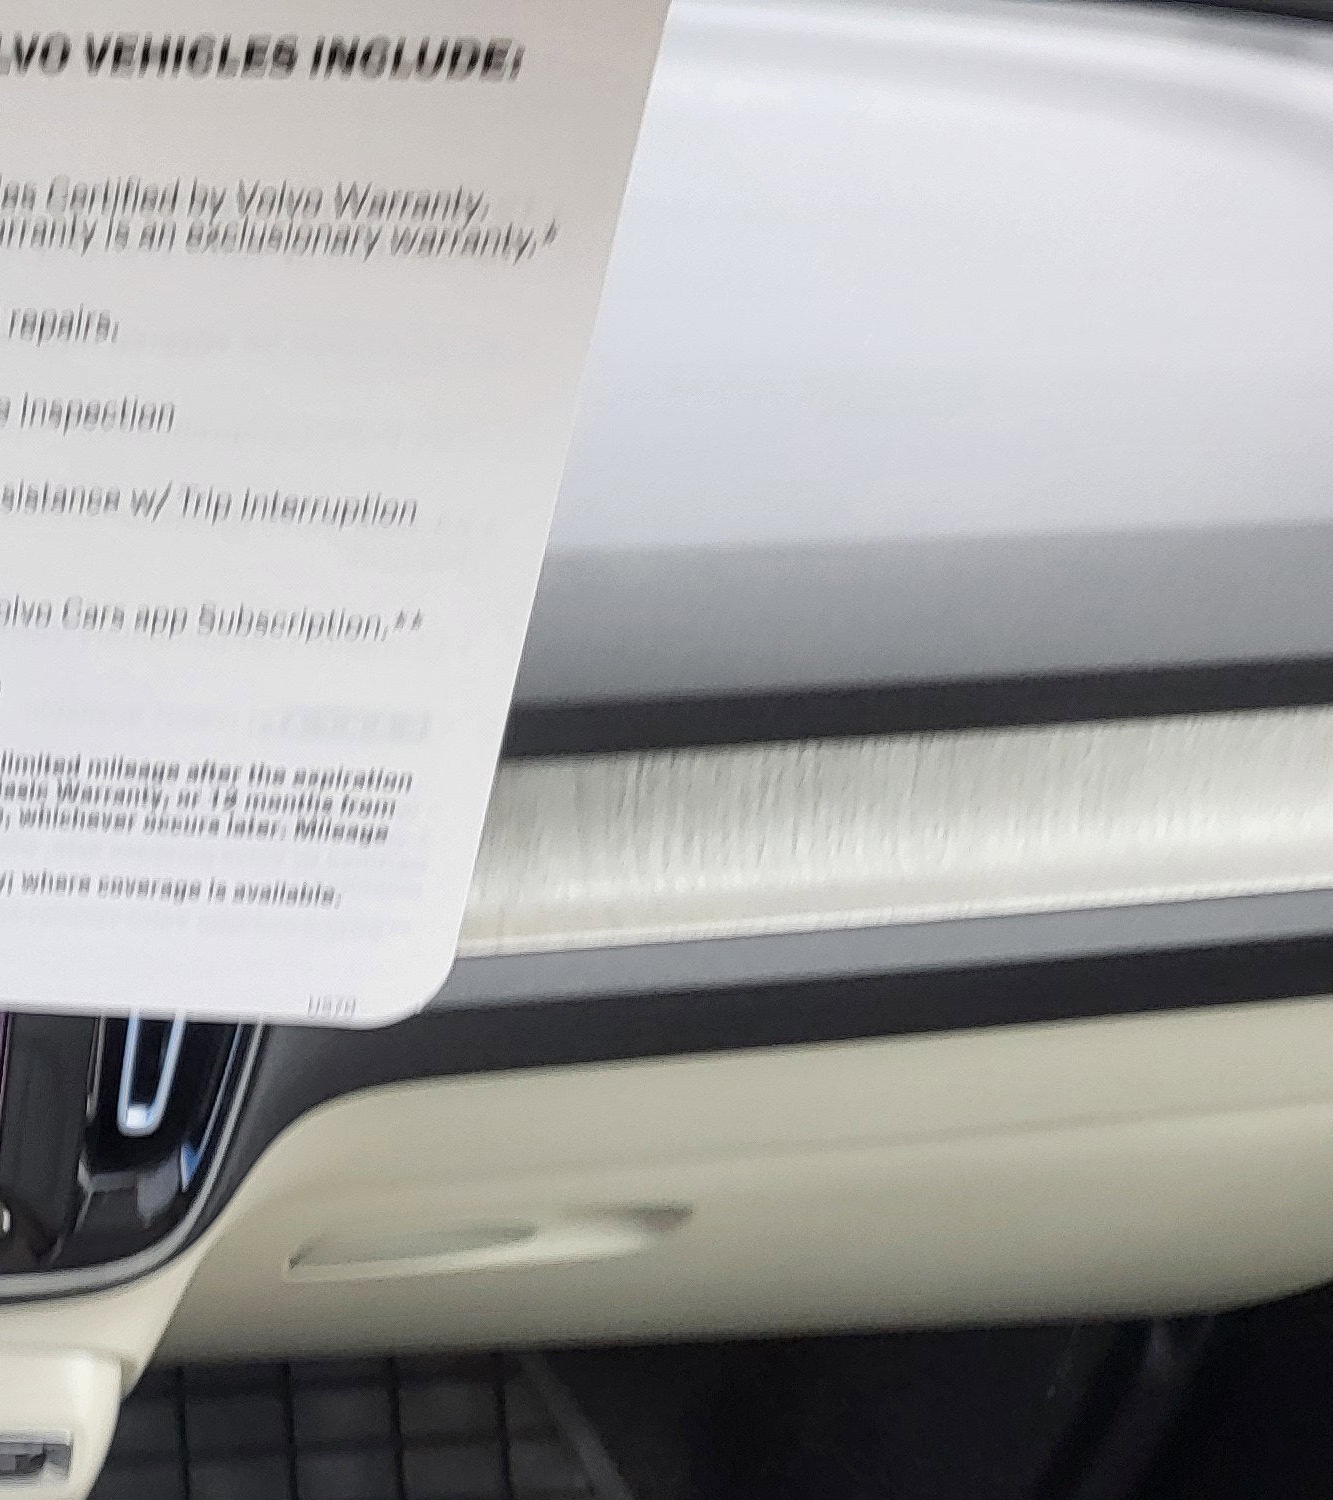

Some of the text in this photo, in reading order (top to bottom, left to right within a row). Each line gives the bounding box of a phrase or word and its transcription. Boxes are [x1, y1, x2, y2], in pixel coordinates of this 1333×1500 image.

[85, 32, 298, 80] VEHICLES
[47, 174, 180, 218] Certified
[190, 177, 226, 225] by
[236, 178, 323, 220] Volvo
[105, 213, 130, 250] is
[138, 221, 176, 254] an
[185, 216, 381, 262] exclusionary
[20, 391, 174, 437] Inspection
[130, 480, 173, 522] w/
[177, 482, 232, 526] Trip
[240, 486, 419, 530] Interruption
[61, 594, 125, 631] Cars
[133, 603, 187, 641] app
